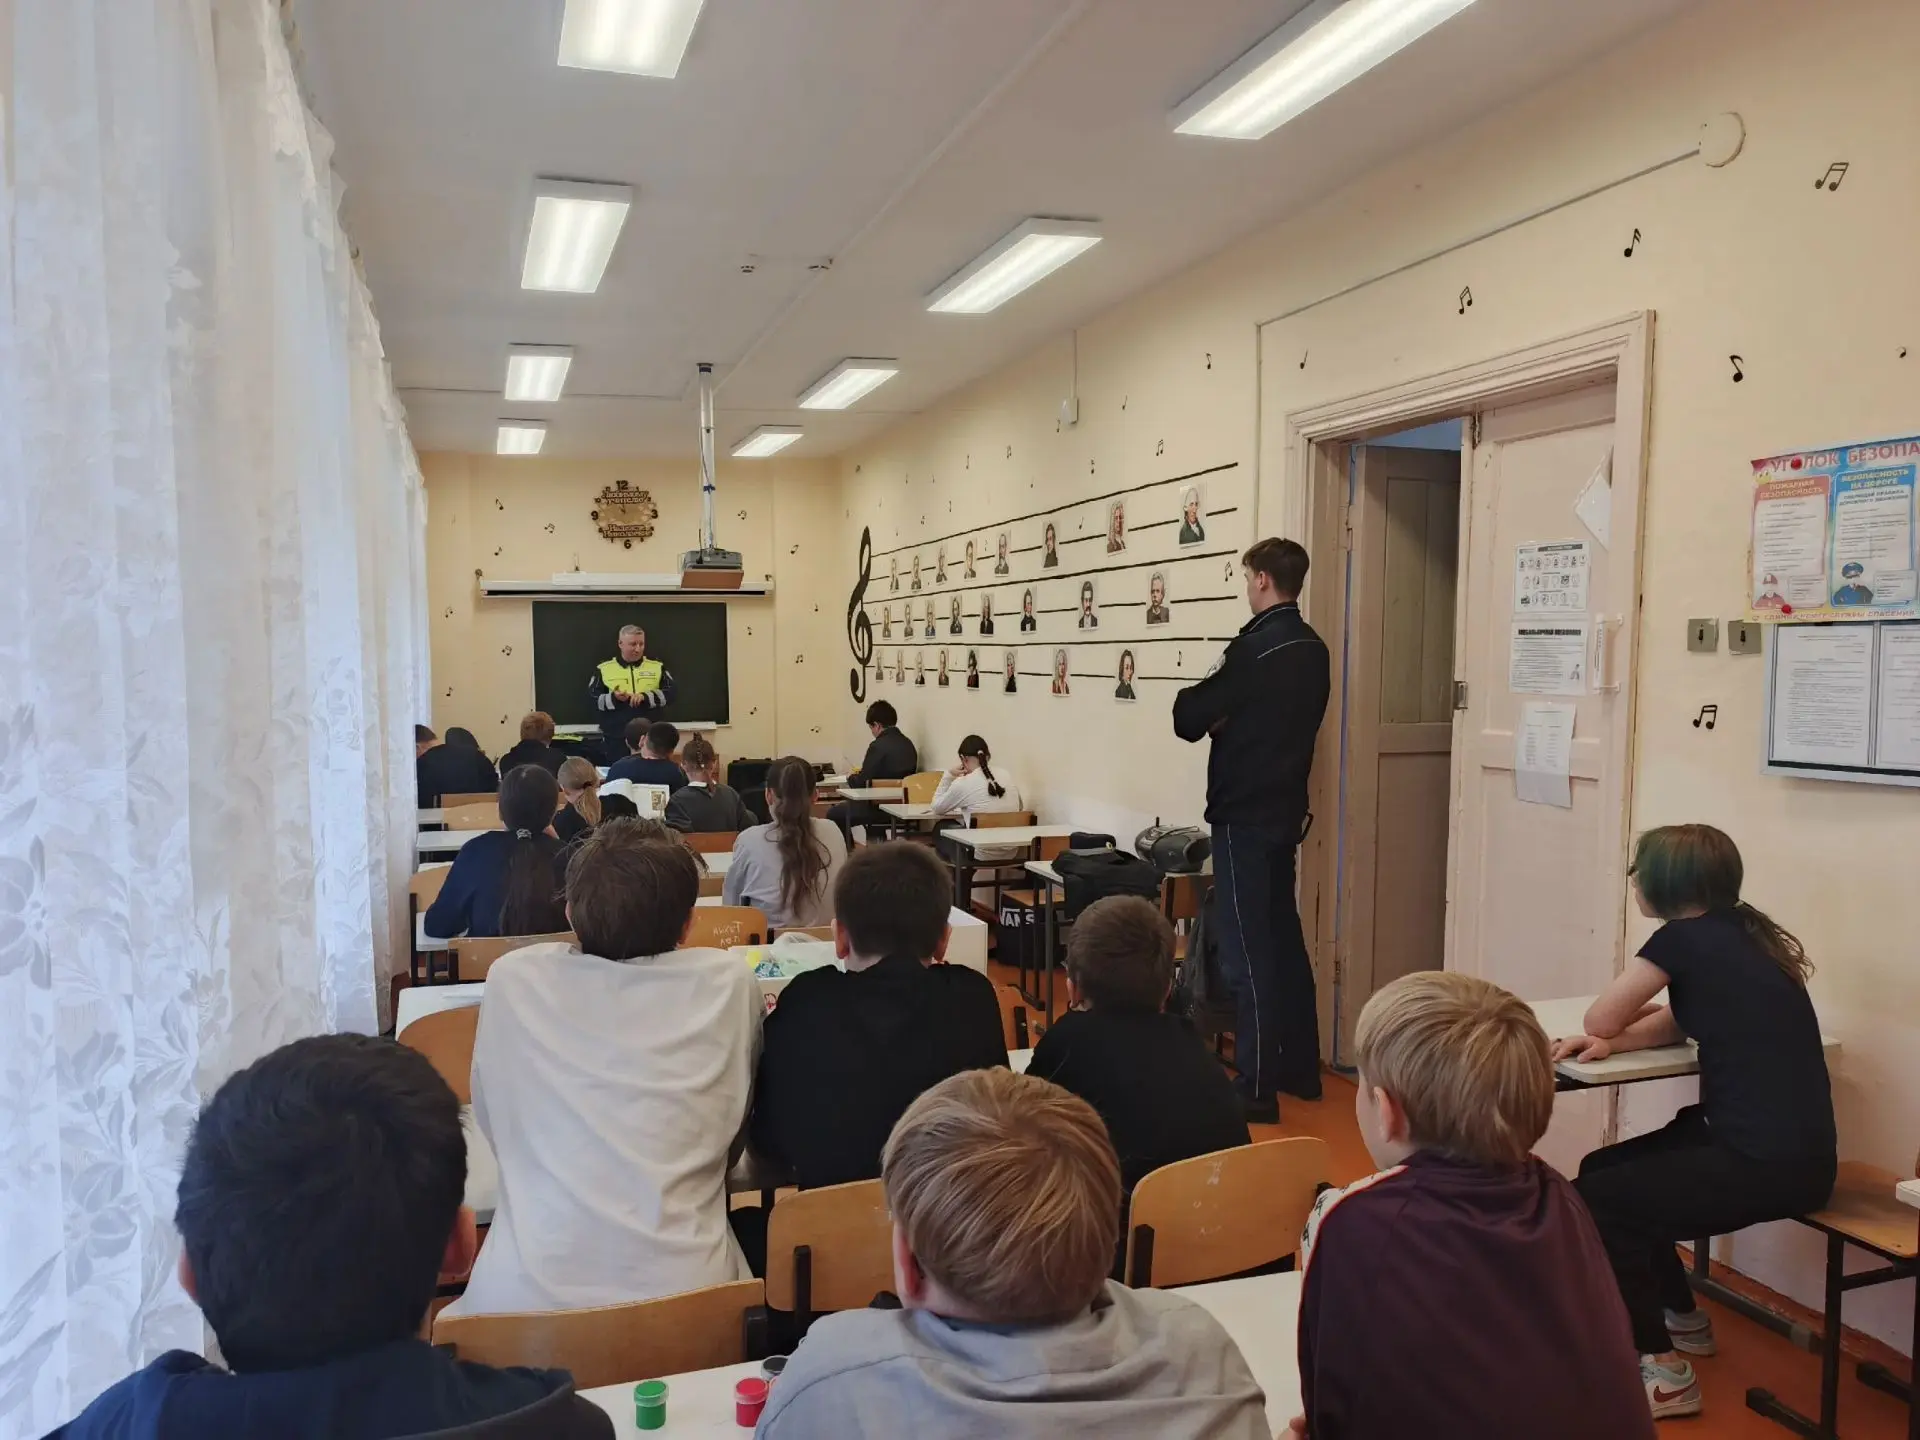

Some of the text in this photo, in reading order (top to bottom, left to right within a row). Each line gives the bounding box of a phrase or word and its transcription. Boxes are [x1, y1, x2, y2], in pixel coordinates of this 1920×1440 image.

[1770, 452, 1838, 473] УГЛОК
[616, 480, 629, 491] 12
[591, 510, 599, 521] 9
[651, 509, 658, 519] 3
[623, 539, 632, 549] 6
